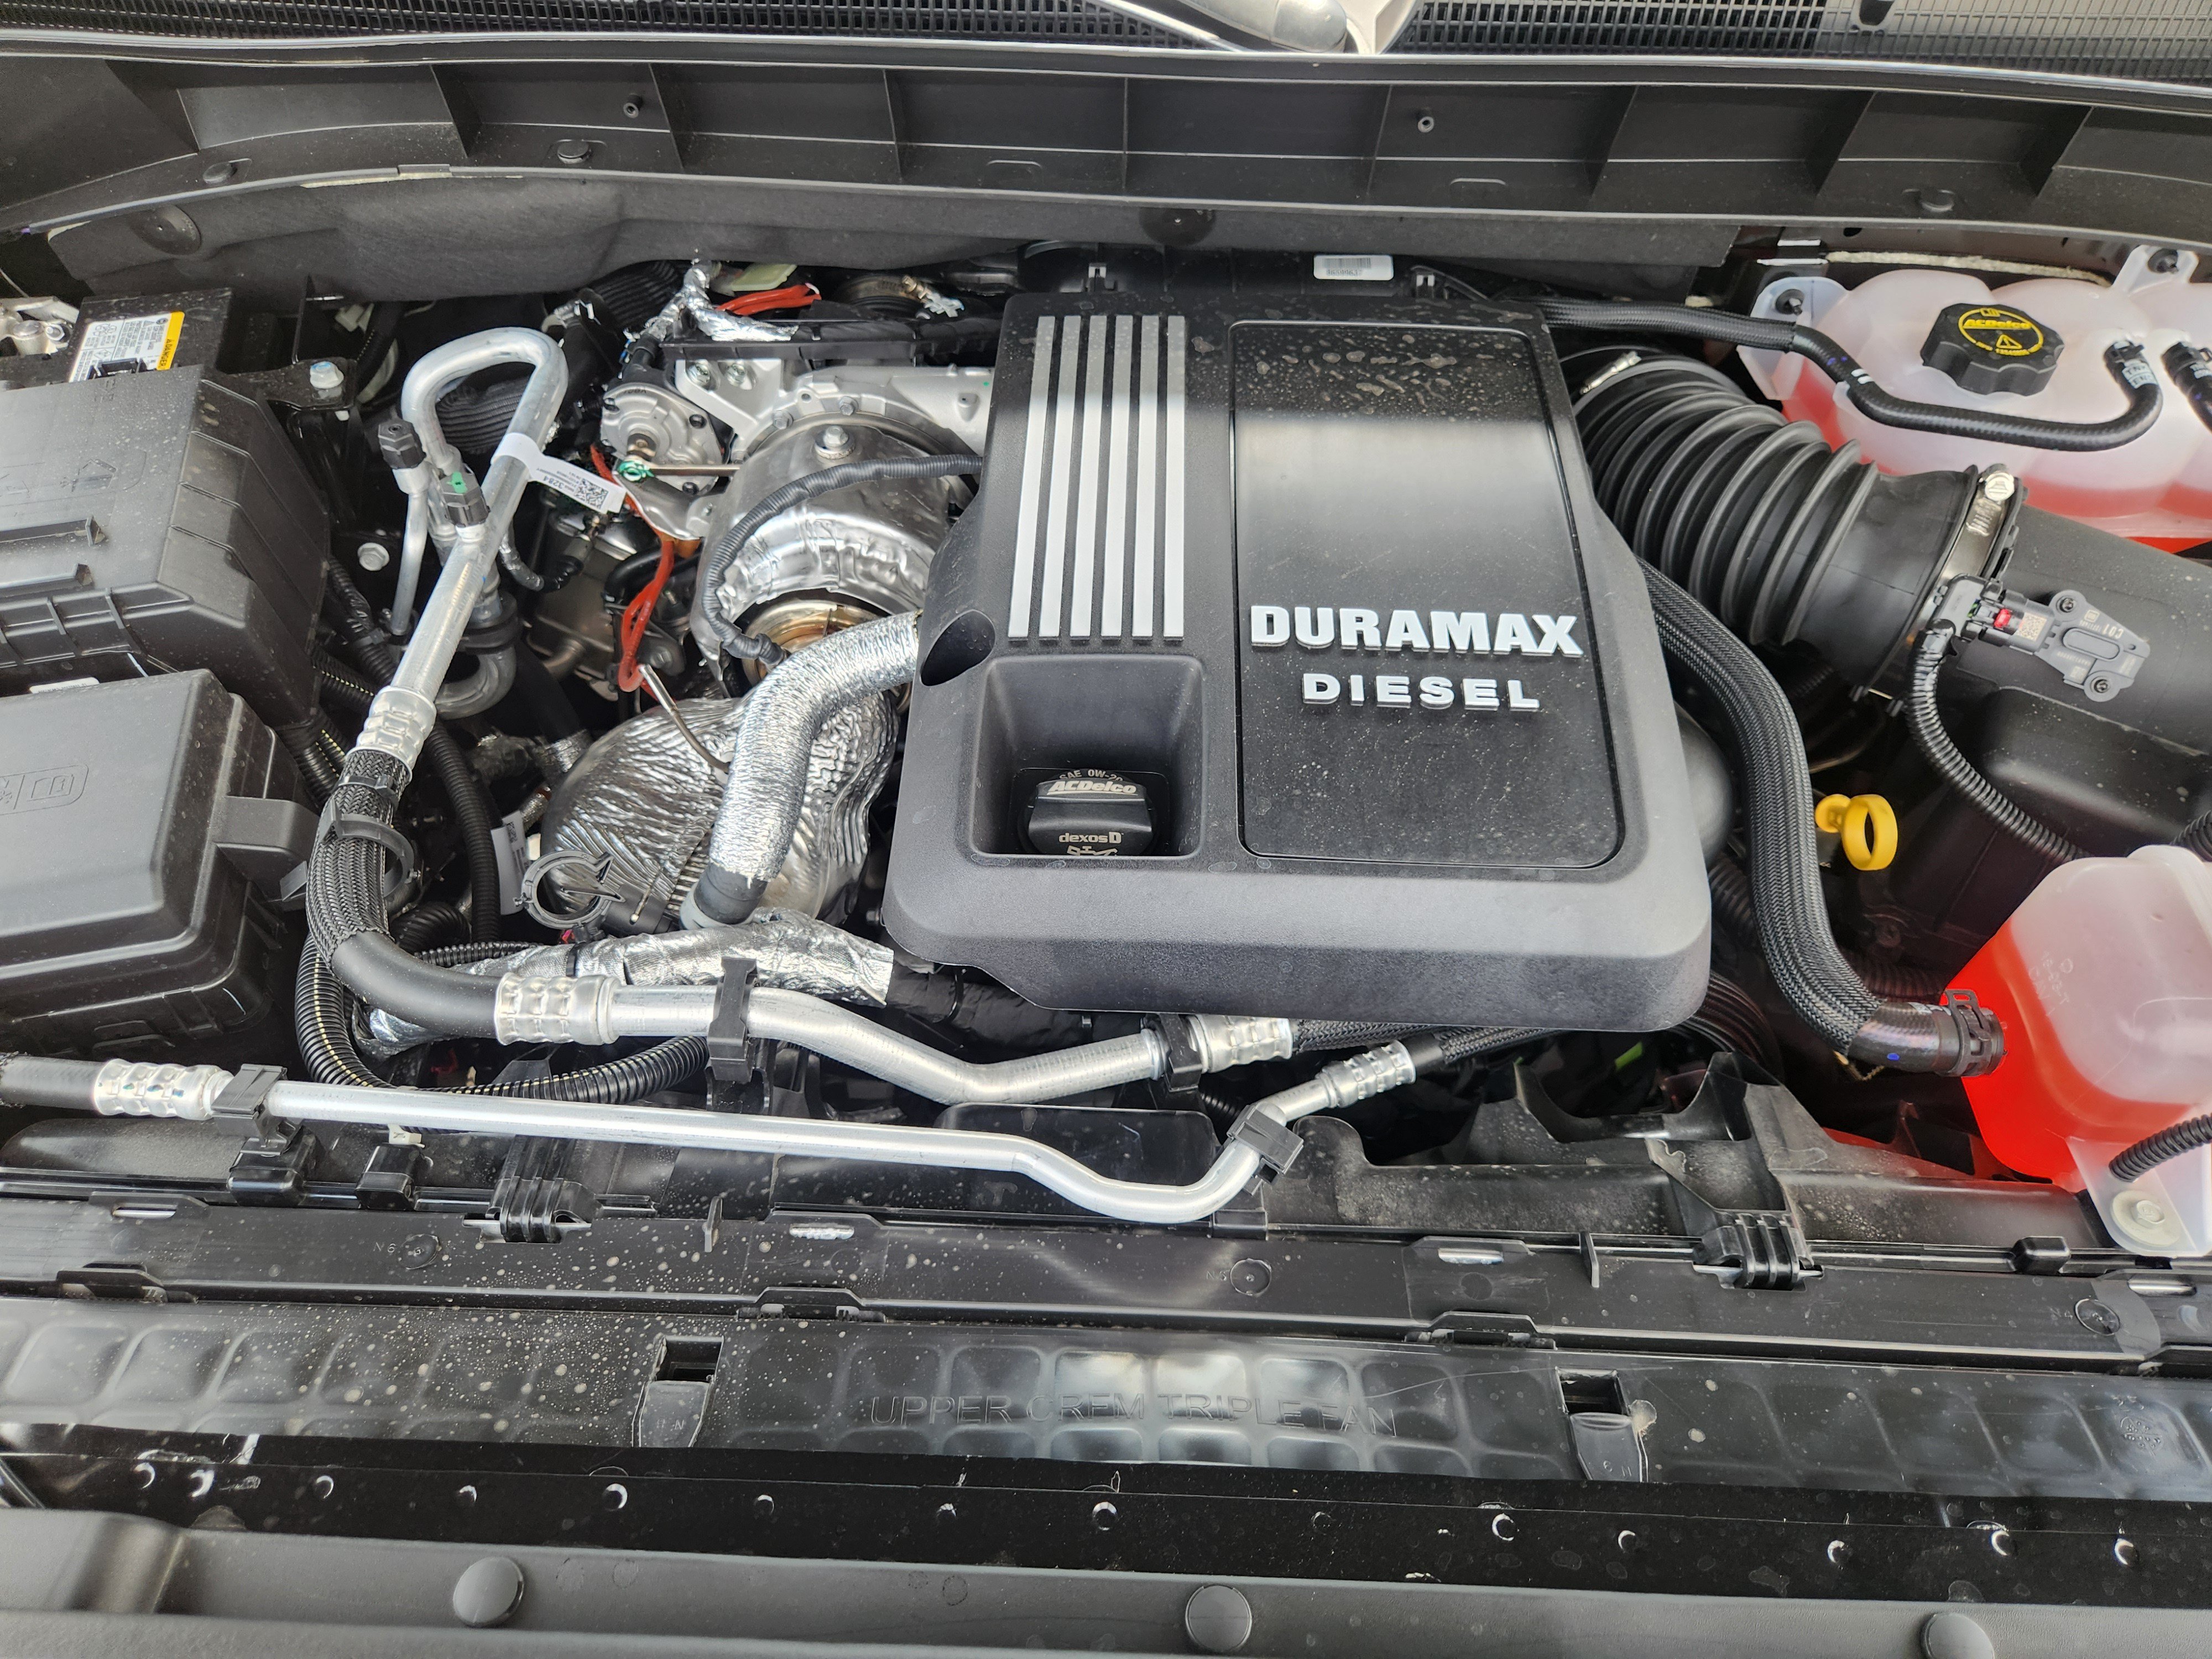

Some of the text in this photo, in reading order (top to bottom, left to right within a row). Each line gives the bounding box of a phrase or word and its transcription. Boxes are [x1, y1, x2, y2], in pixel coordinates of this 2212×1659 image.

[1251, 605, 1584, 658] DURAMAX
[1302, 673, 1541, 711] DIESEL
[1047, 780, 1137, 795] ACDelco
[1060, 770, 1082, 779] SAE
[870, 1395, 1013, 1426] UPPER
[1157, 1393, 1305, 1429] TRIPLE
[1318, 1403, 1397, 1438] FAN
